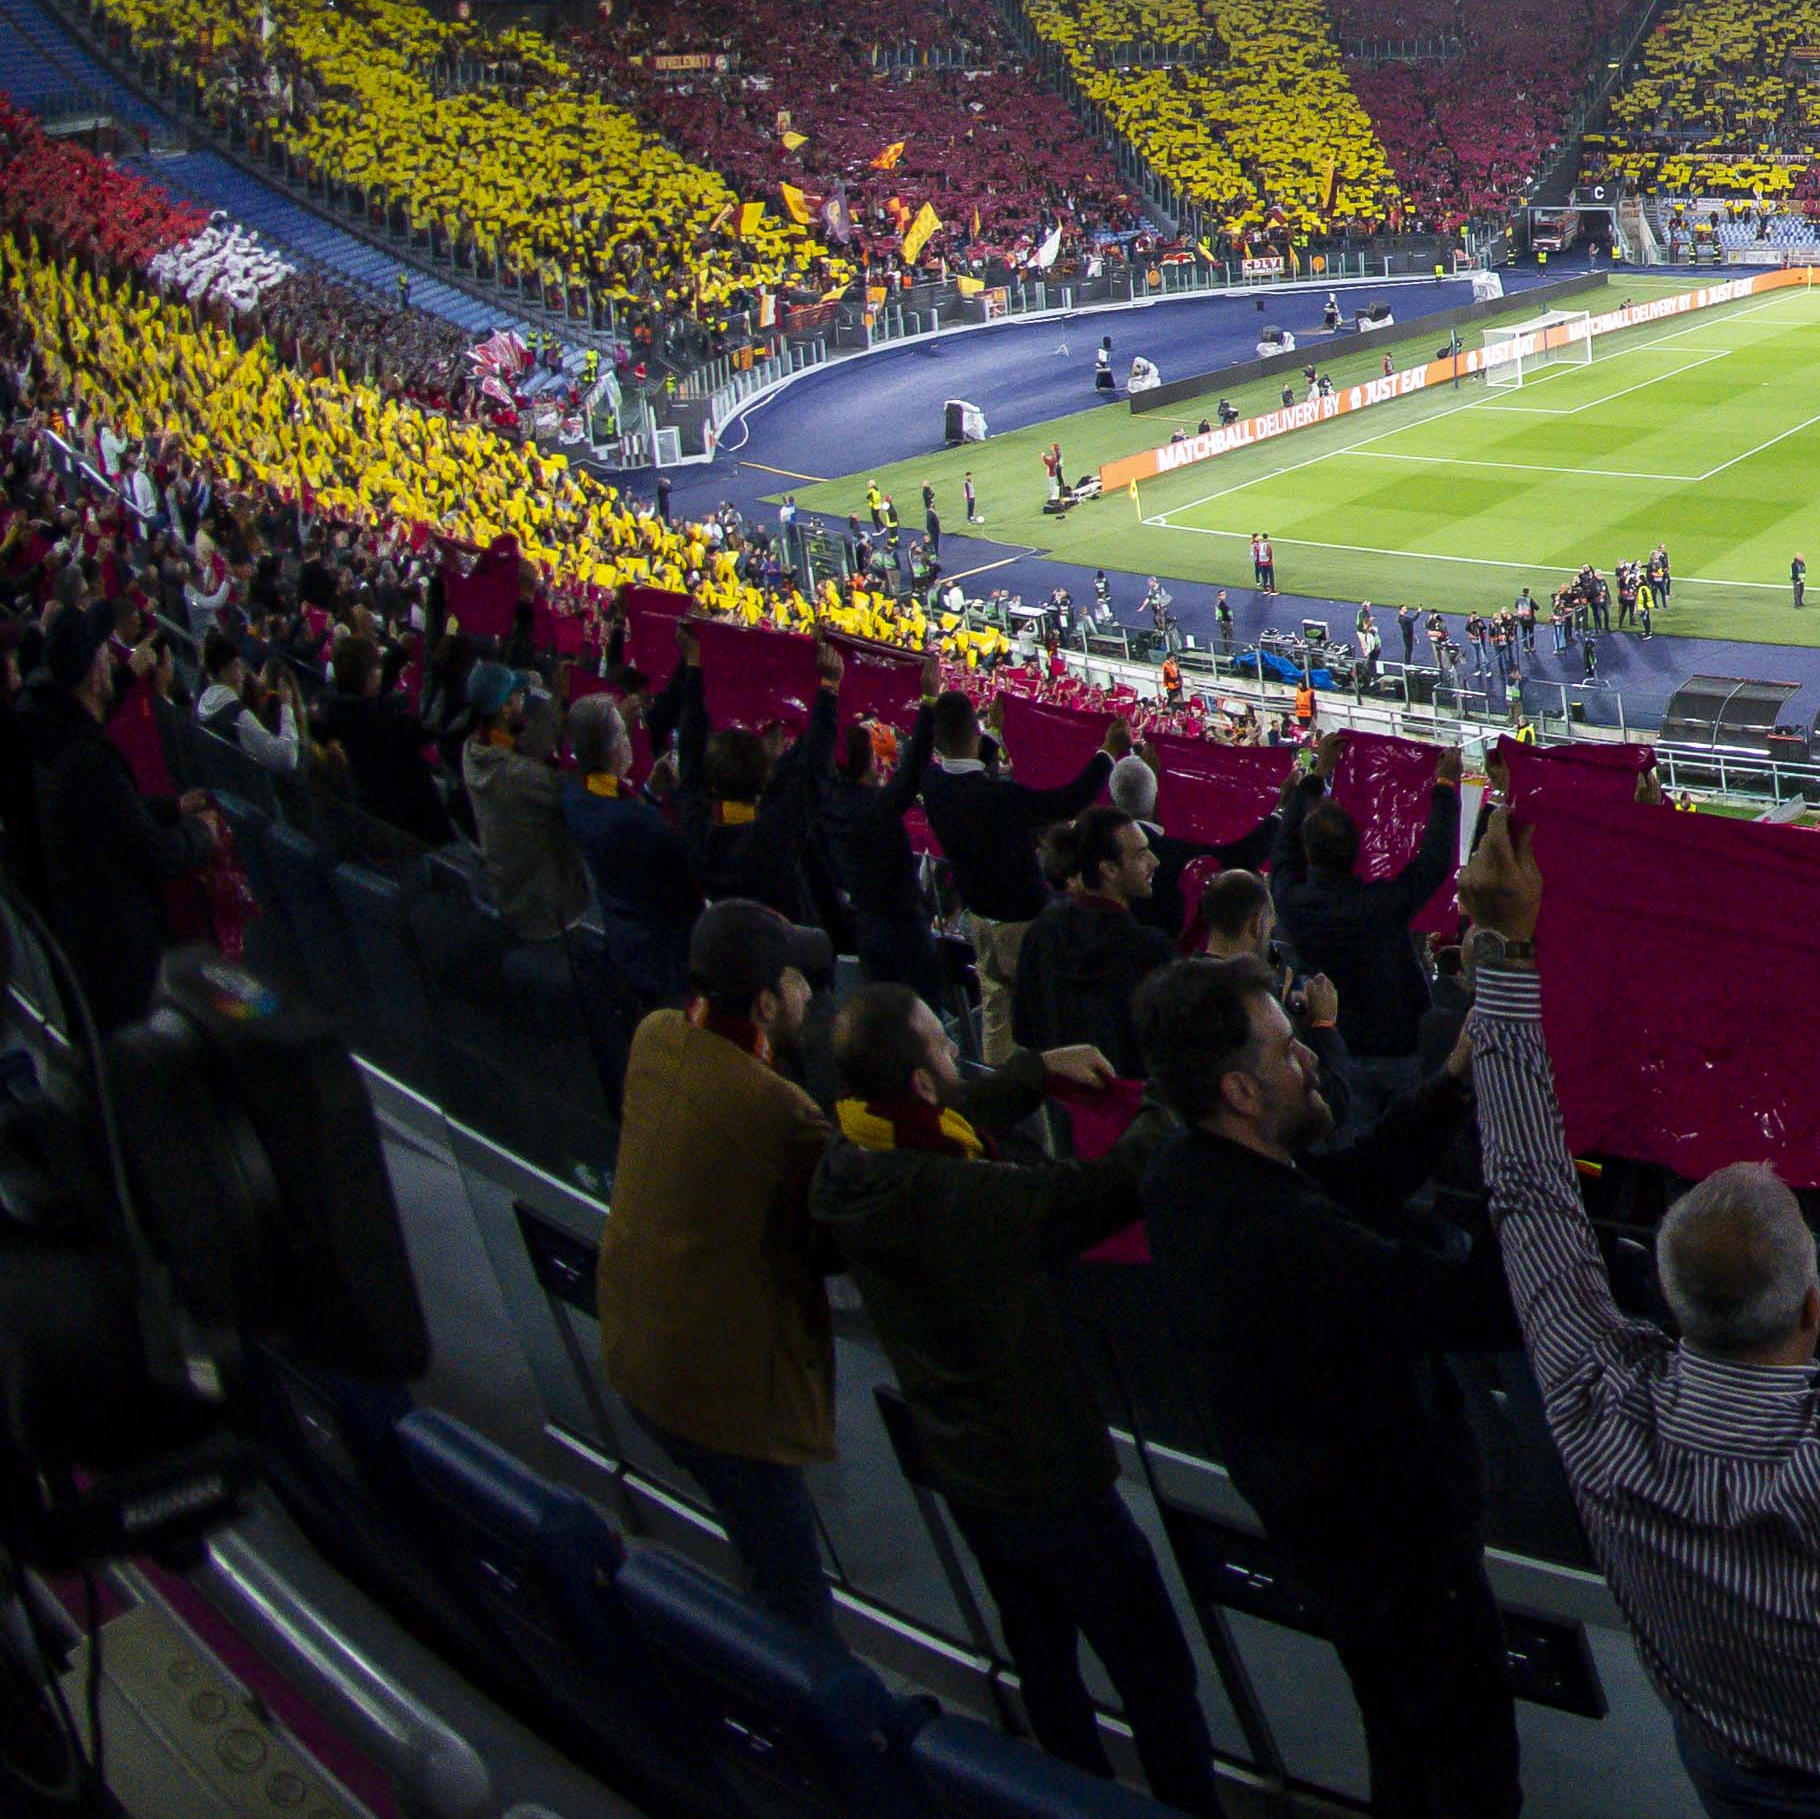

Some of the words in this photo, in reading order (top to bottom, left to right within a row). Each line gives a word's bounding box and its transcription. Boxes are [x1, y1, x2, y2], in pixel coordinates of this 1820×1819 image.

[1594, 186, 1605, 199] C
[1704, 283, 1734, 305] JUST
[1734, 276, 1754, 298] EAT
[1633, 297, 1676, 320] DELIVERY
[1676, 293, 1691, 311] BY
[1480, 339, 1513, 370] JUST
[1363, 372, 1400, 406] JUST
[1400, 365, 1429, 394] EAT
[1158, 418, 1255, 472] MATCHBALL
[1256, 399, 1322, 442] DELIVERY
[1323, 393, 1341, 416] BY
